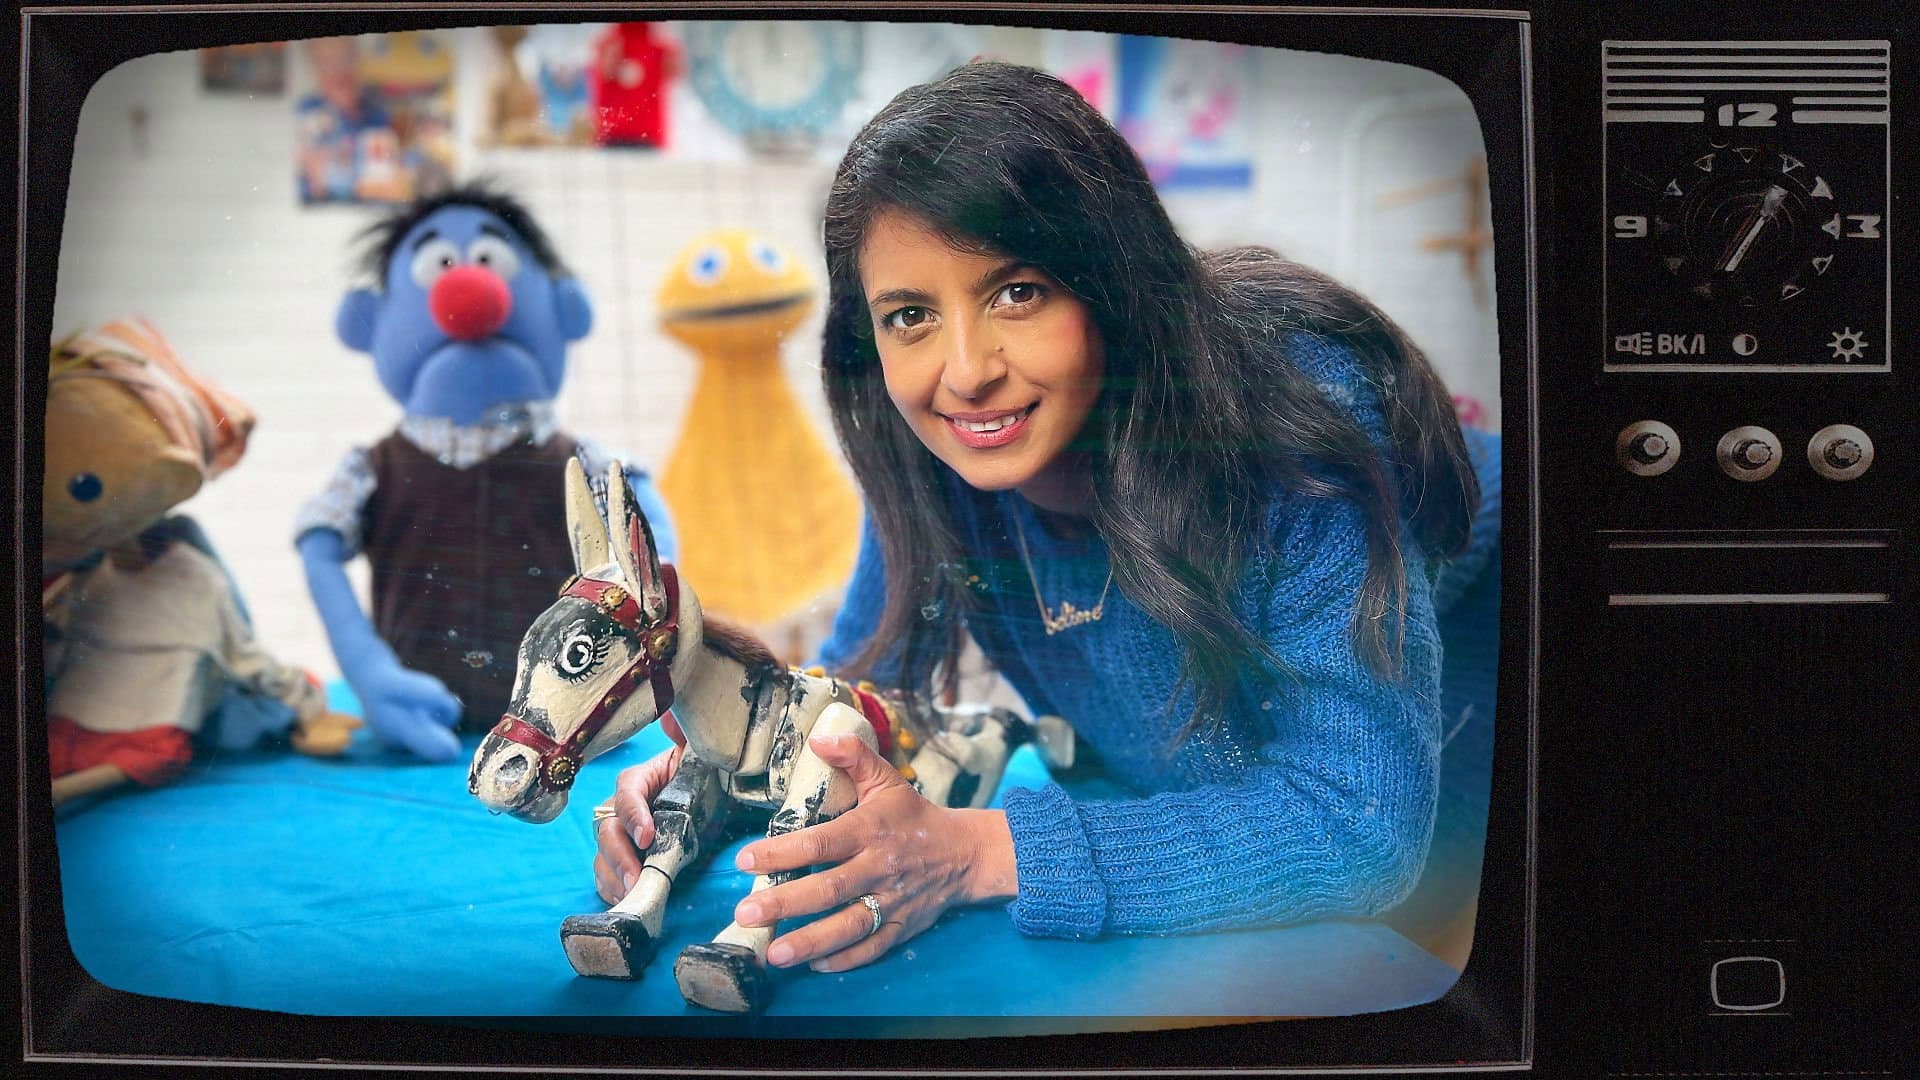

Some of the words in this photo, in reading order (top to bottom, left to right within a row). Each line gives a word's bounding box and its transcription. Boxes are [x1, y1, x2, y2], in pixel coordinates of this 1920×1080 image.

[1718, 102, 1778, 127] 12
[1614, 215, 1648, 238] 9
[1657, 333, 1706, 355] ВКЛ
